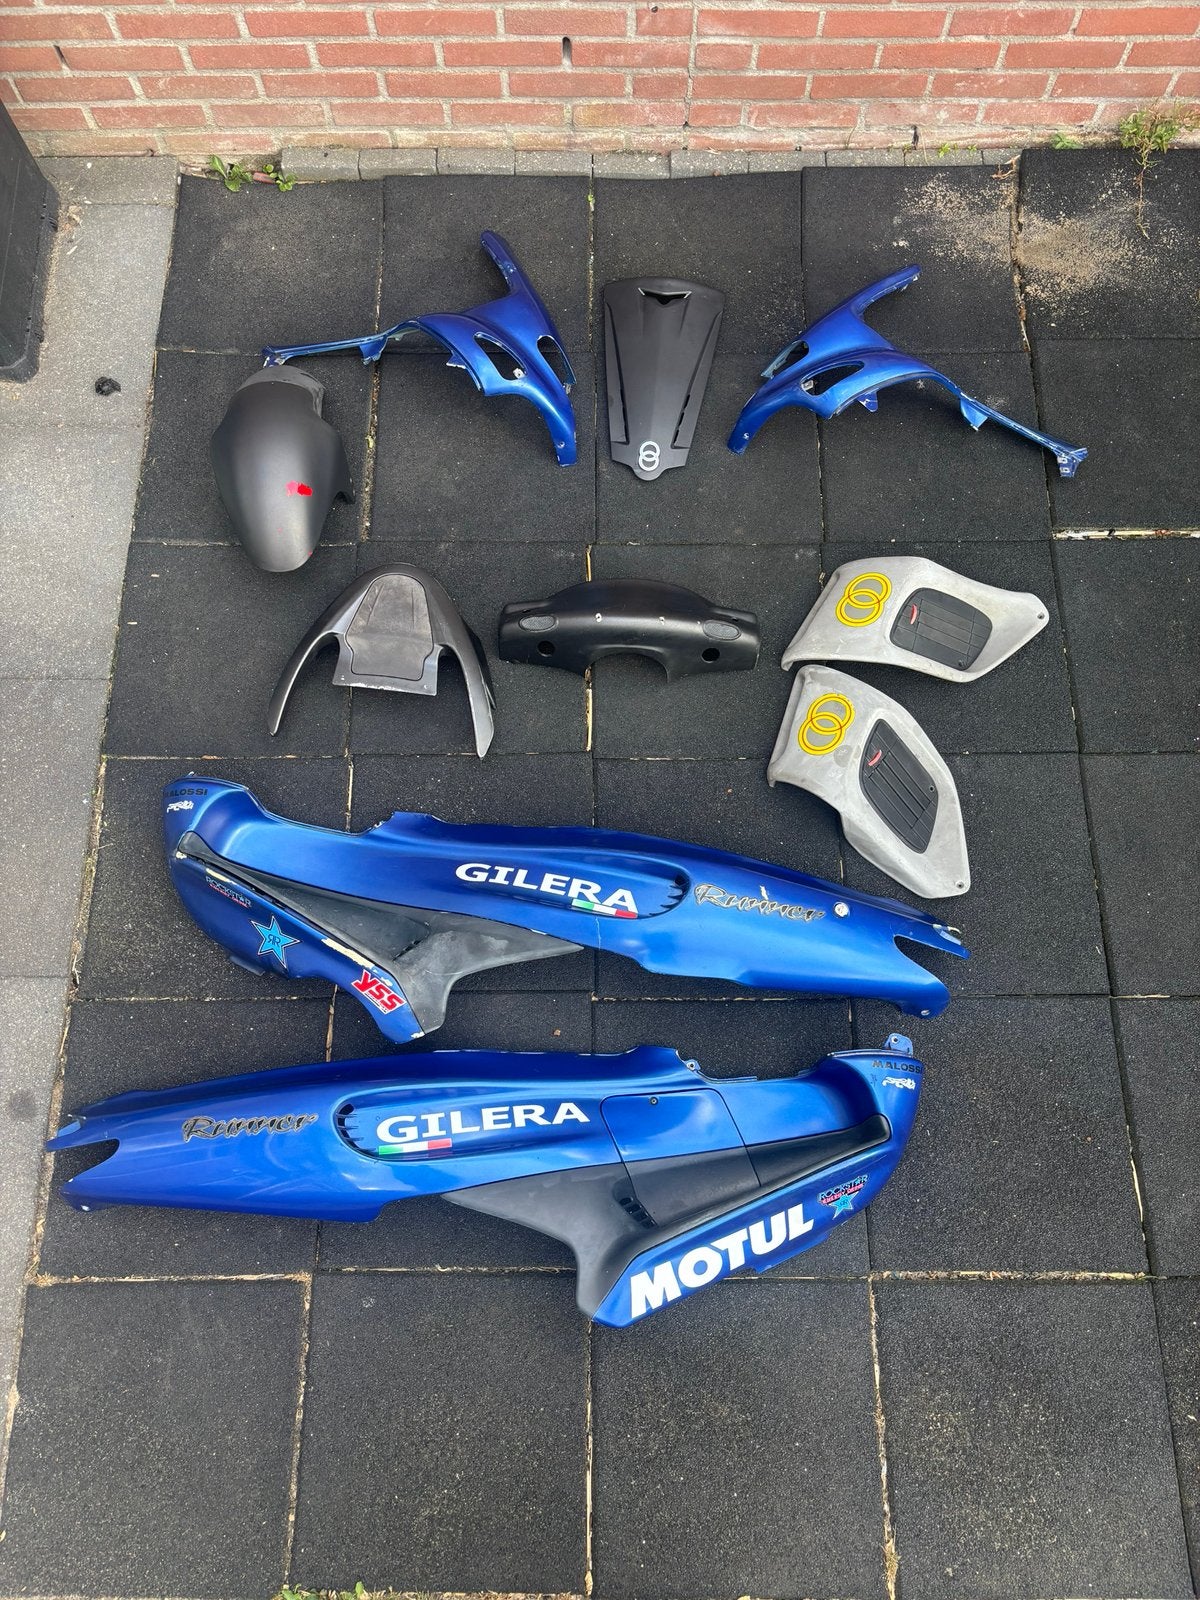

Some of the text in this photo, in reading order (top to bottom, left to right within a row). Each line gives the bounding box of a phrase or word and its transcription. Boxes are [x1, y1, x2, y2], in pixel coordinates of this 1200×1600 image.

[454, 862, 639, 915] GILERA
[352, 970, 406, 1011] YSS
[182, 1114, 319, 1143] Runner
[376, 1101, 591, 1144] GILERA
[630, 1203, 815, 1319] MOTUL
